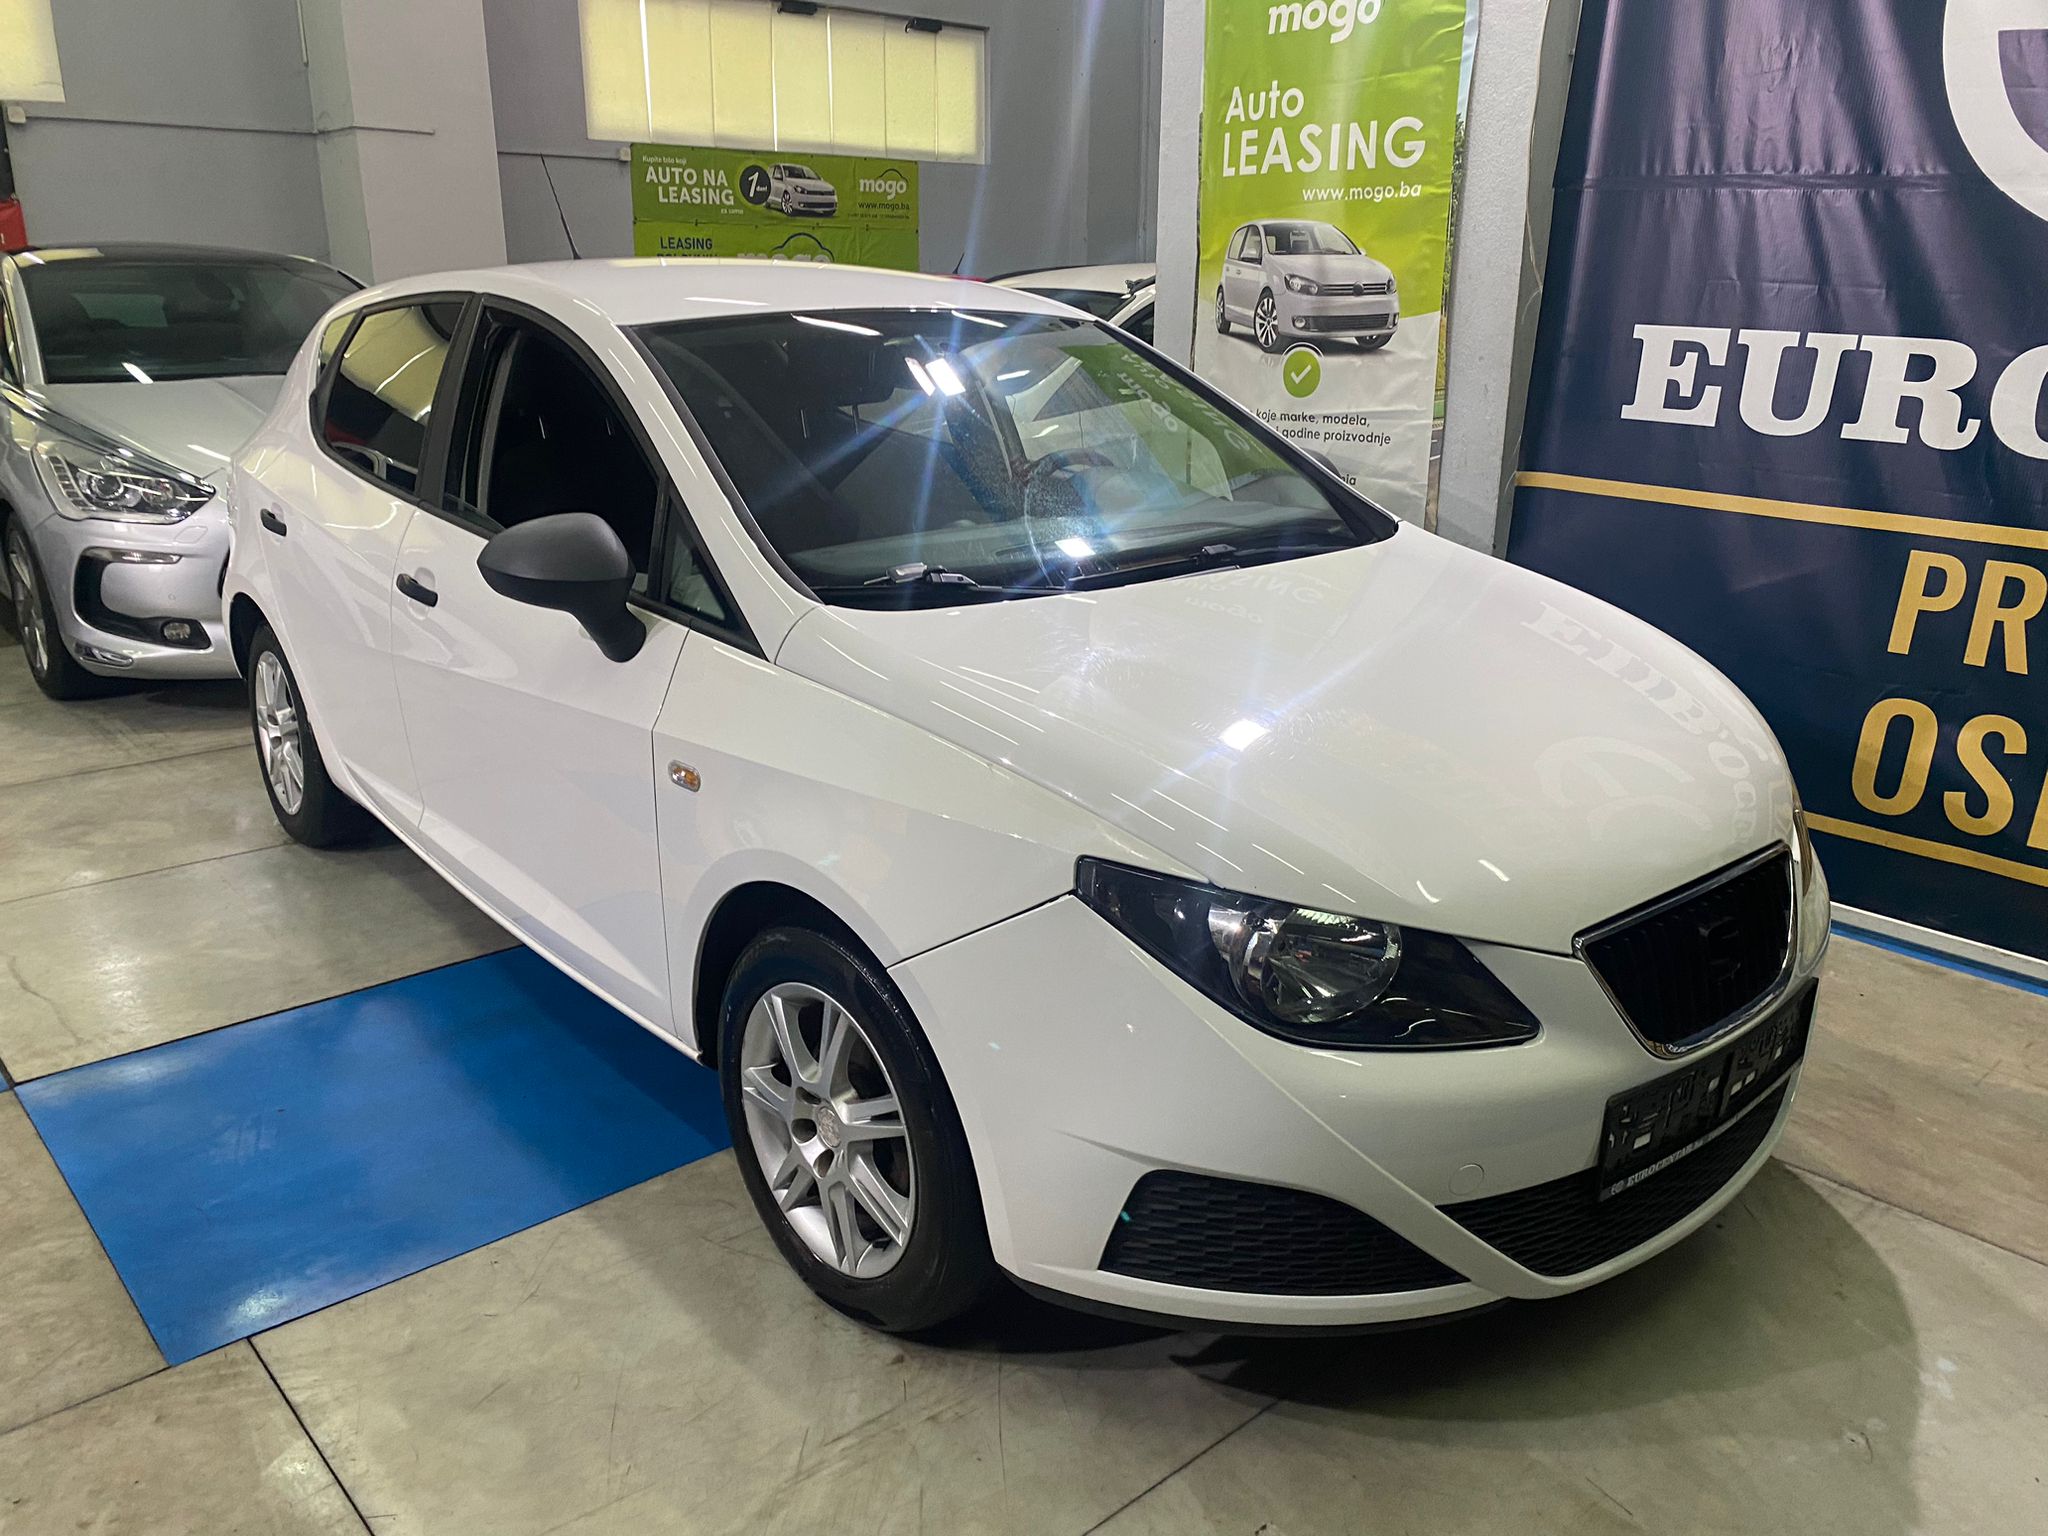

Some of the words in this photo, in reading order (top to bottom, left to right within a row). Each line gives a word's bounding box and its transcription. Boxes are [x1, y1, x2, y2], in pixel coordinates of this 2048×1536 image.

[1268, 0, 1382, 44] mogo
[1225, 80, 1305, 124] Auto
[1222, 116, 1426, 177] LEASING
[645, 166, 698, 185] AUTO
[703, 169, 728, 187] NA
[748, 171, 759, 197] 1
[658, 186, 735, 206] LEASING
[859, 178, 907, 200] mogo
[1302, 181, 1422, 202] www.mogo.ba
[857, 202, 910, 212] www.mogo.ba
[660, 236, 713, 250] LEASING
[1256, 409, 1277, 423] koje
[1280, 412, 1319, 425] marke,
[1322, 414, 1370, 428] modela,
[1282, 428, 1320, 440] godine
[1323, 430, 1391, 447] proizvodnje
[1887, 550, 2048, 675] PR
[1852, 698, 2048, 851] OS
